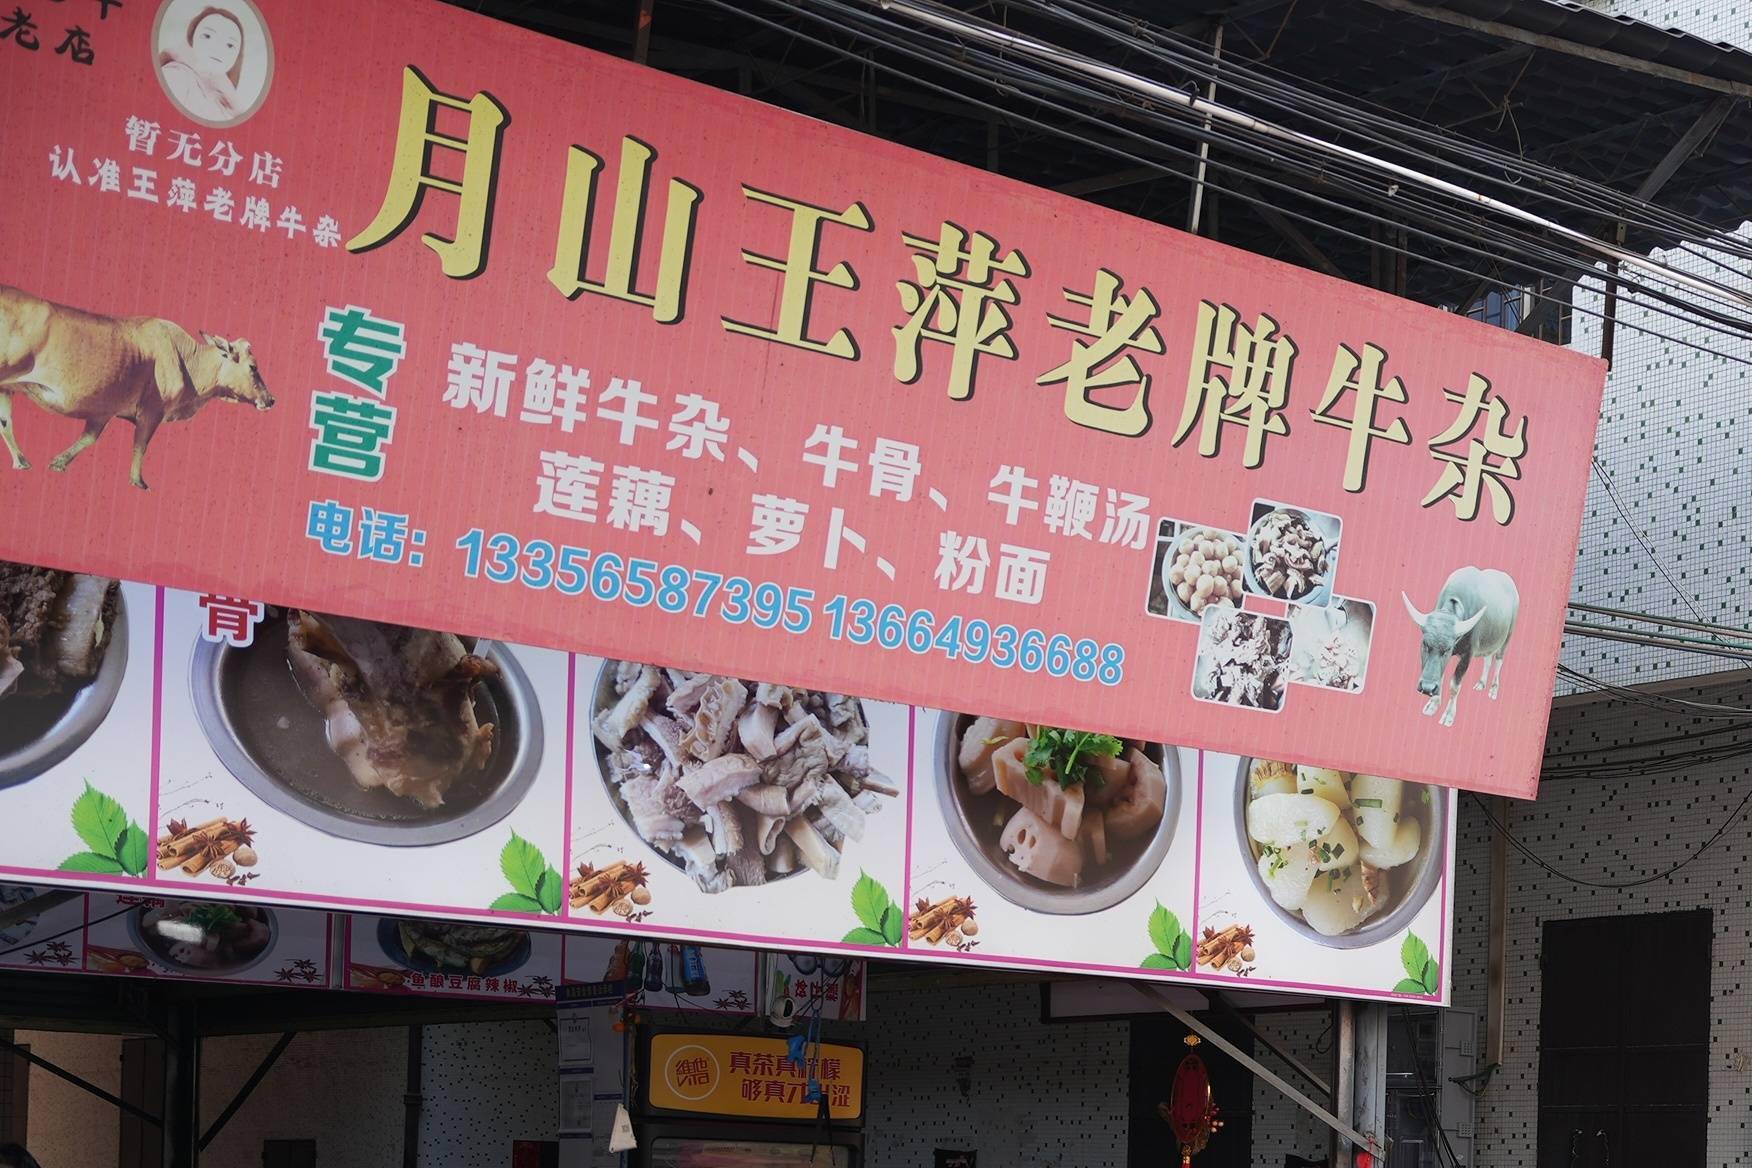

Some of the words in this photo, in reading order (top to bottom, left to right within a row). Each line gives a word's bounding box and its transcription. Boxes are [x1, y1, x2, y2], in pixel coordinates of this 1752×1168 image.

[0, 6, 94, 65] 老店
[49, 145, 342, 249] 认准王萍老牌牛杂
[125, 115, 284, 189] 暂无分店
[345, 64, 1528, 525] 月山王萍老牌牛杂
[308, 304, 407, 482] 专营
[823, 593, 1125, 687] 13664936688
